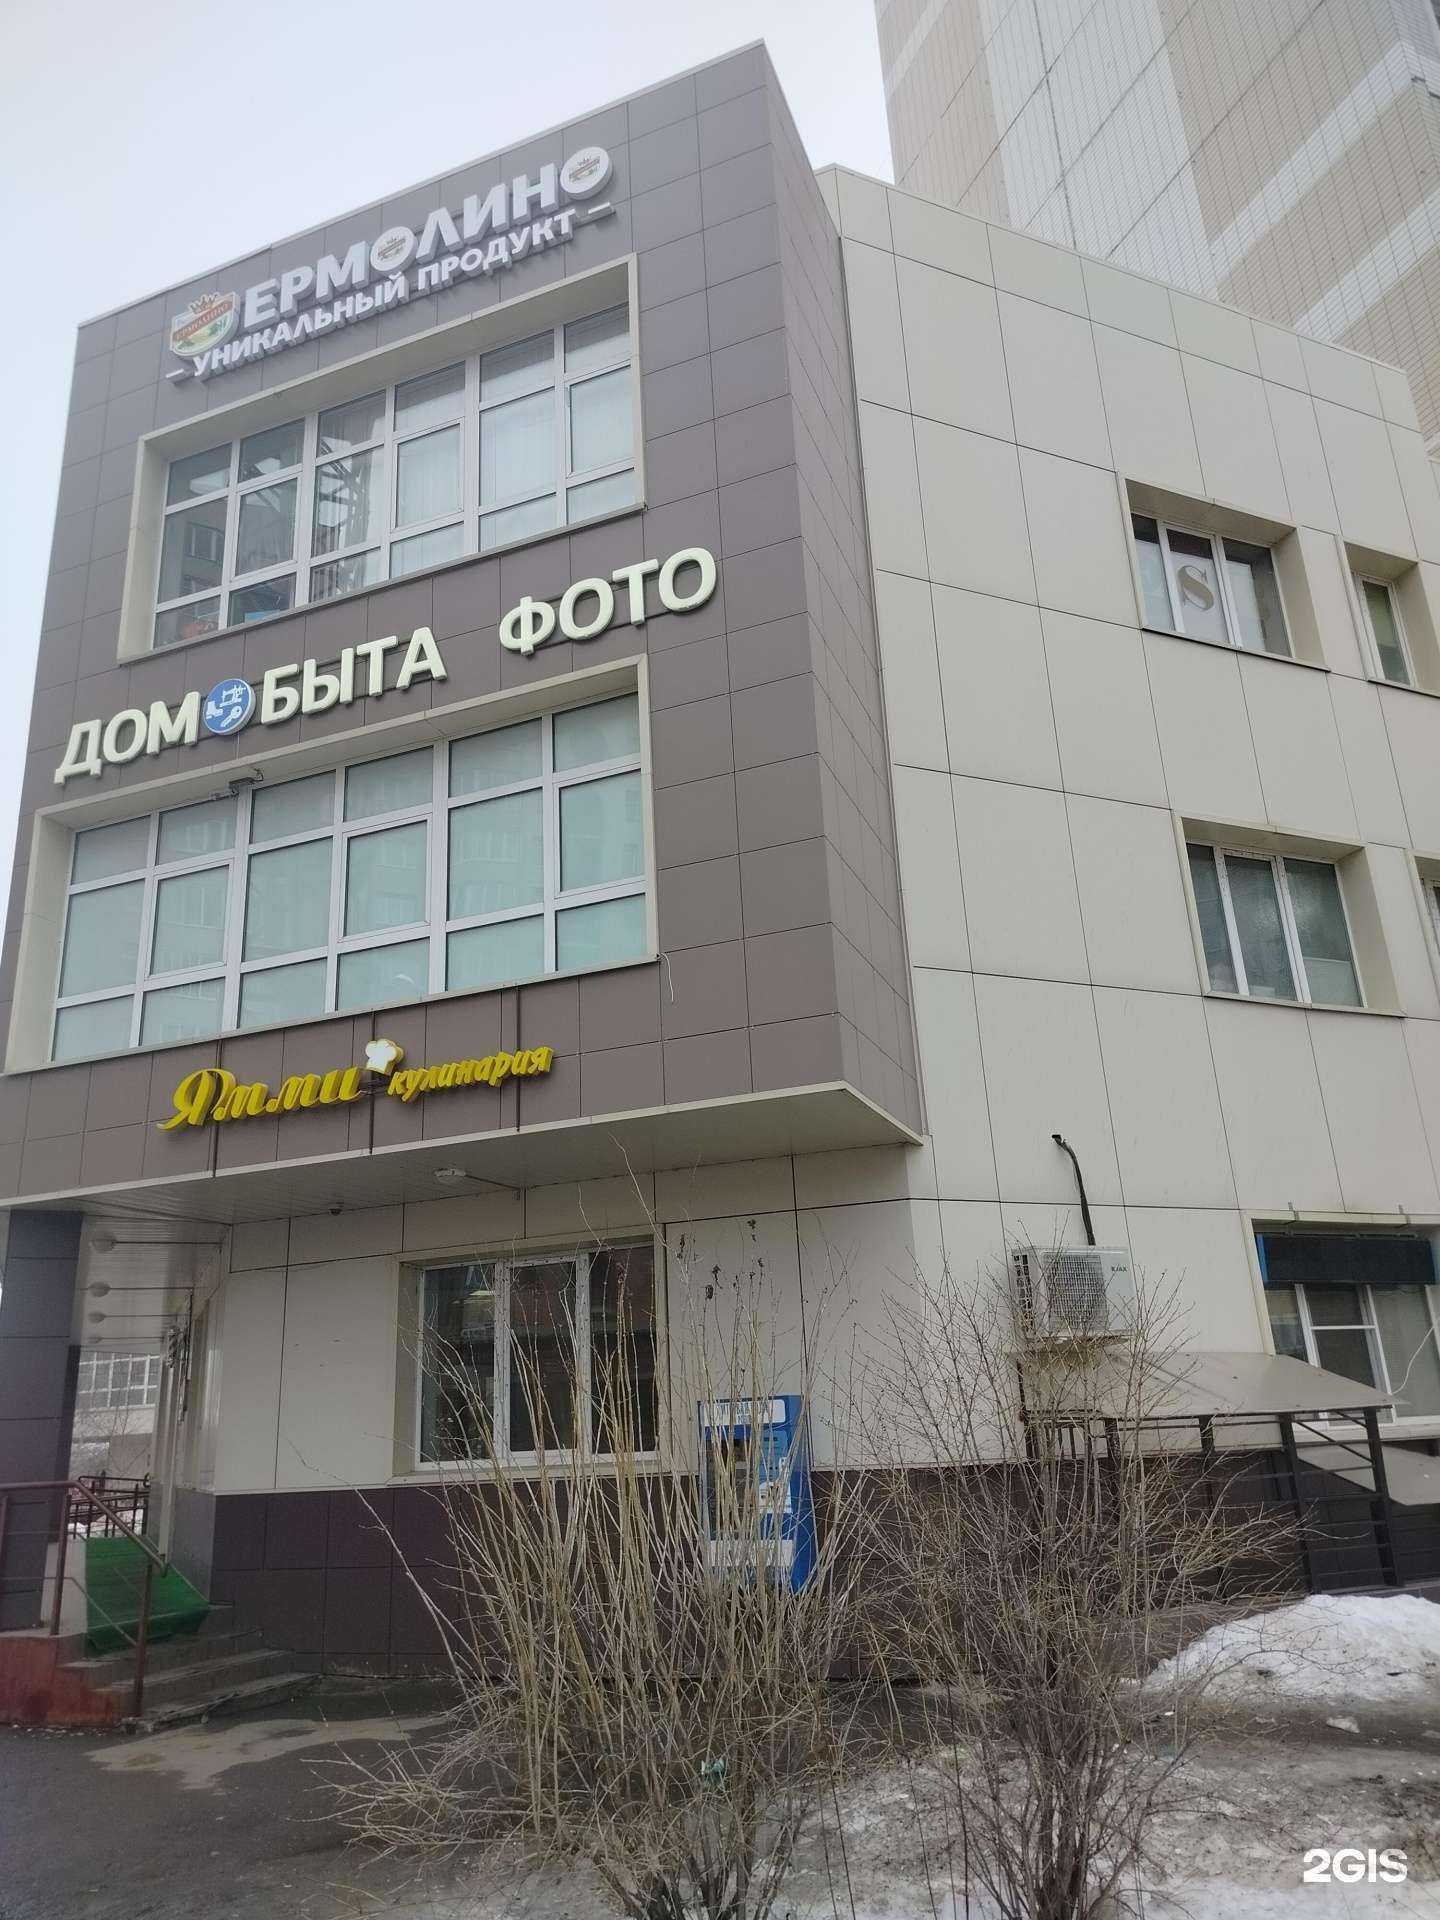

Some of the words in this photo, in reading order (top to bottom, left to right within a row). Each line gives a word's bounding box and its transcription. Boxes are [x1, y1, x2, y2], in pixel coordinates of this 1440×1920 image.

[193, 271, 409, 379] УНИКАЛЬНЫЙ
[418, 208, 577, 291] ПРОДУКТ
[243, 146, 613, 330] ЕРМОЛИНО
[54, 691, 201, 784] ДОМ
[259, 627, 448, 726] БЫТА
[499, 547, 718, 656] ФОТО
[1177, 565, 1215, 611] S
[387, 1046, 555, 1103] кулинария
